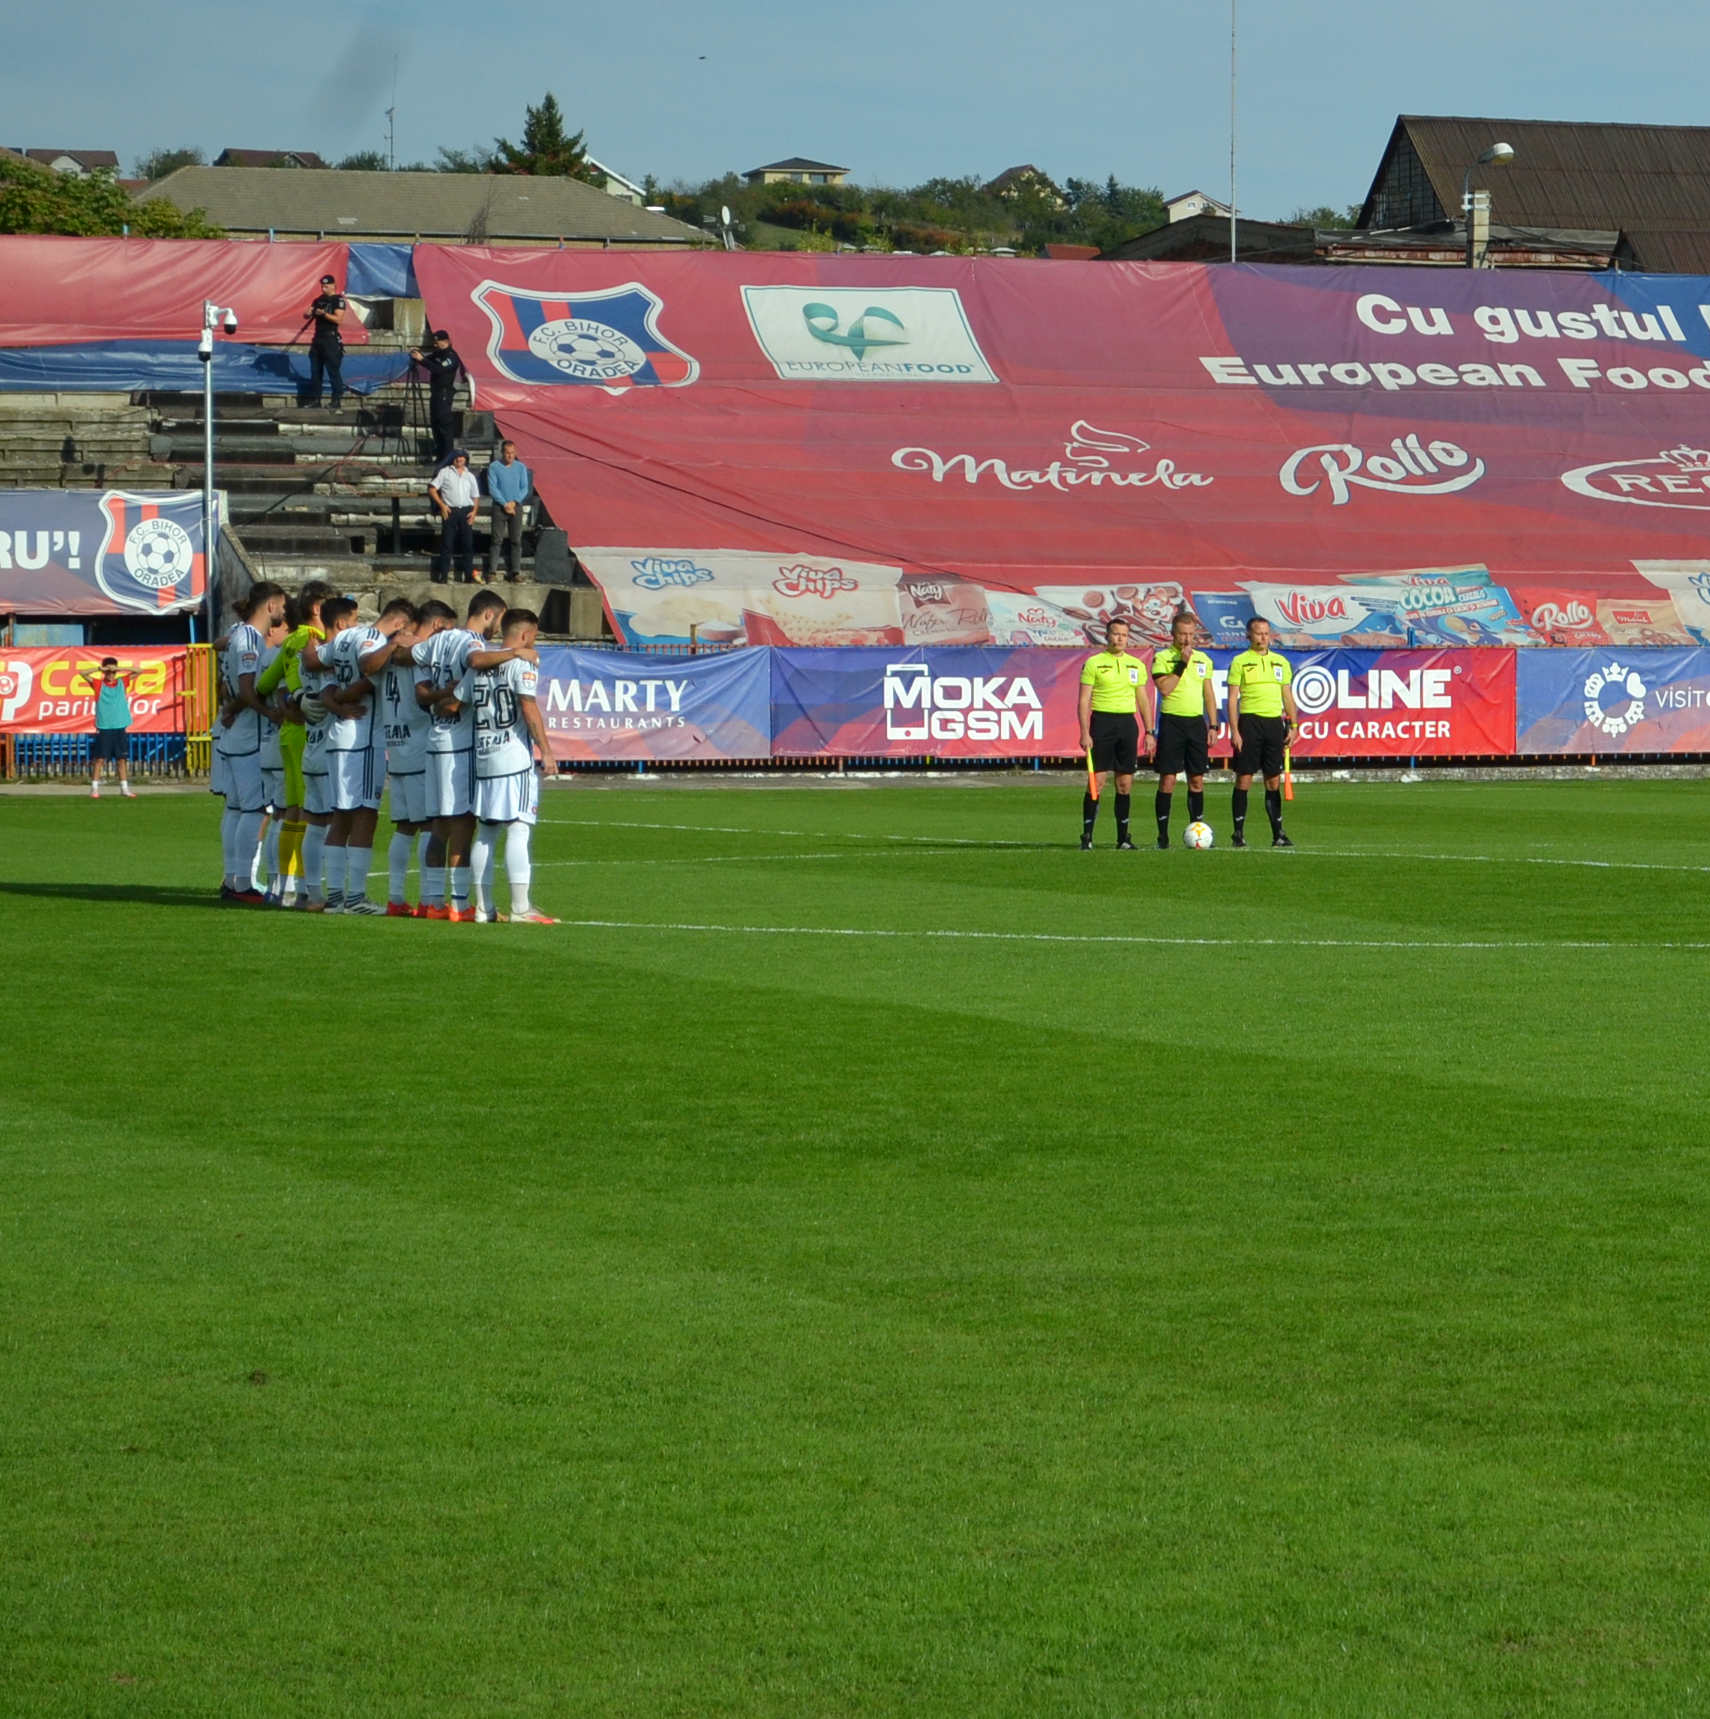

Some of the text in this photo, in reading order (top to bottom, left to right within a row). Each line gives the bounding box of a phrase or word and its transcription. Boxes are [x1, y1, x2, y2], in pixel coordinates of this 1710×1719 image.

[1357, 294, 1454, 335] Cu
[1474, 304, 1686, 343] gustul
[533, 321, 628, 347] F.C. BIHOR
[557, 360, 639, 378] ORADEA
[1200, 357, 1546, 392] European
[892, 440, 1213, 491] Matinela
[1280, 434, 1484, 504] Rollo
[129, 520, 188, 545] F.C. BIHOR
[134, 568, 185, 587] ORADEA
[631, 557, 696, 575] Viva
[779, 565, 843, 580] Viva
[632, 568, 714, 590] Chips
[773, 577, 858, 599] Chips
[910, 583, 941, 598] Naty
[1275, 591, 1349, 626] Viva
[1400, 587, 1458, 610] COCOA
[1018, 612, 1056, 627] Naty
[1532, 600, 1594, 630] Rollo
[546, 679, 687, 712] MARTY
[884, 677, 1042, 709] MOKA
[38, 697, 161, 720] parilor
[473, 684, 517, 729] 20
[549, 717, 685, 729] RESTAURANTS
[931, 710, 1043, 740] GSM
[1300, 721, 1450, 739] CU CARACTER
